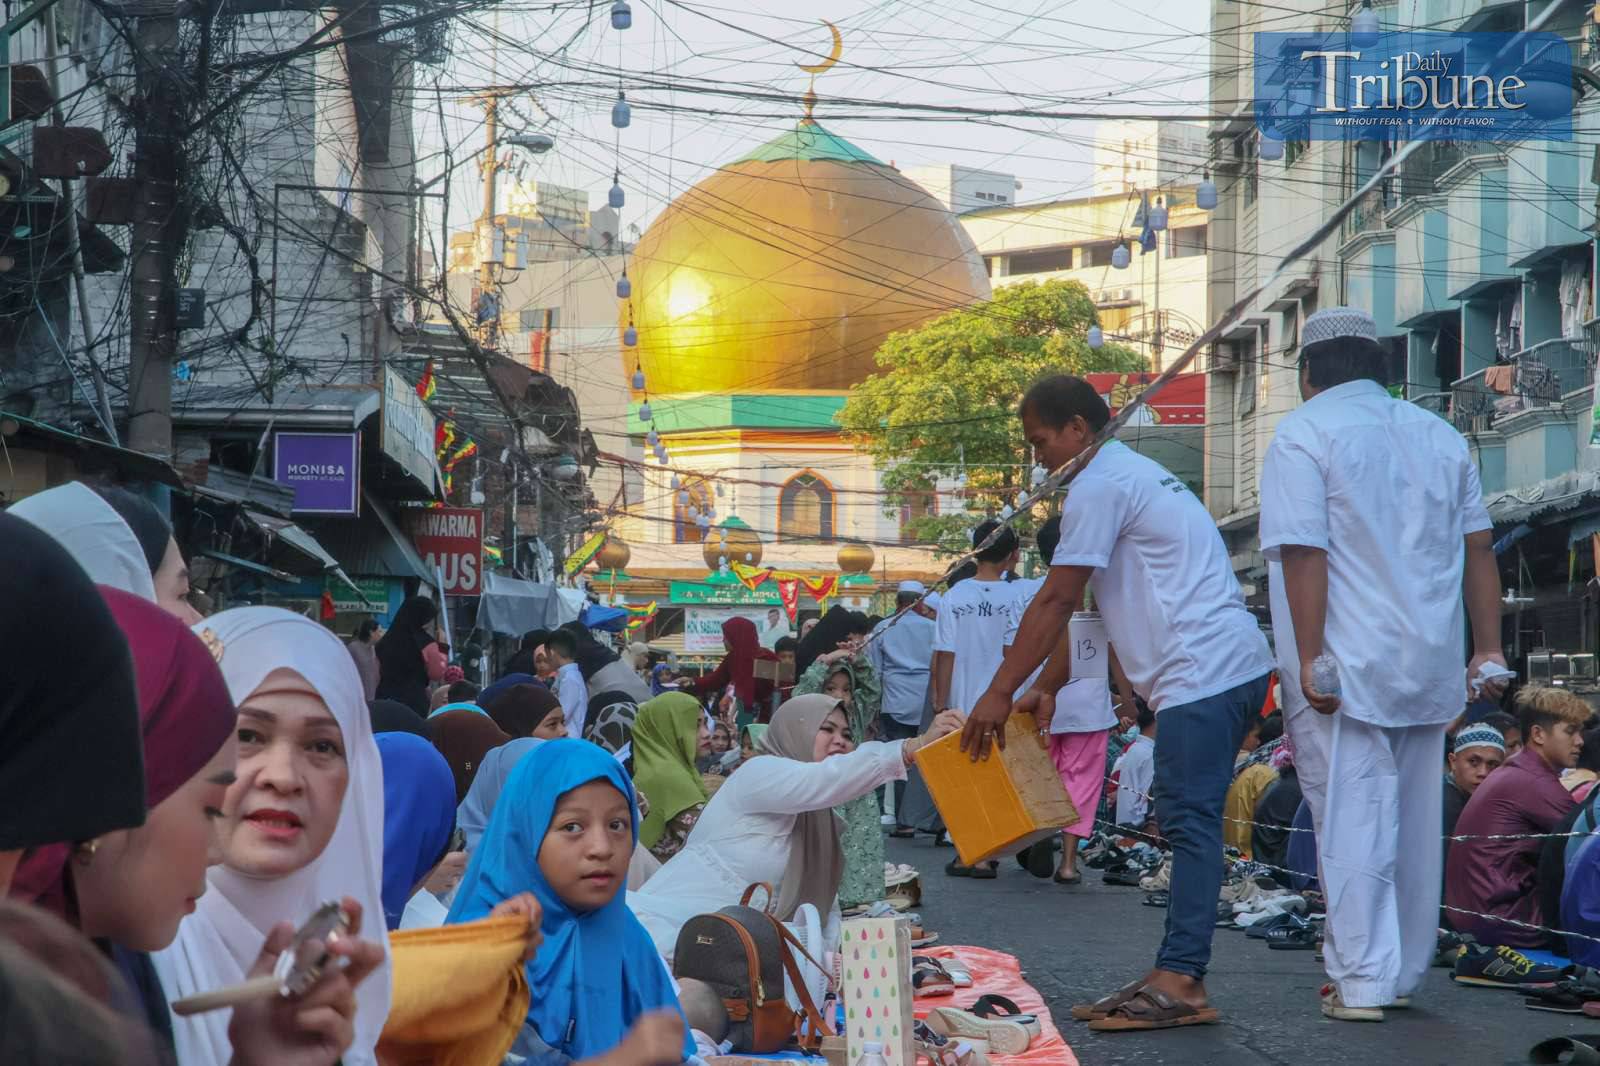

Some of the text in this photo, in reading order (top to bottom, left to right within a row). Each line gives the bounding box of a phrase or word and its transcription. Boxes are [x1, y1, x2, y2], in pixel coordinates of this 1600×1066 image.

[287, 464, 345, 475] MONISA
[424, 552, 477, 591] AUS
[1077, 639, 1097, 661] 13
